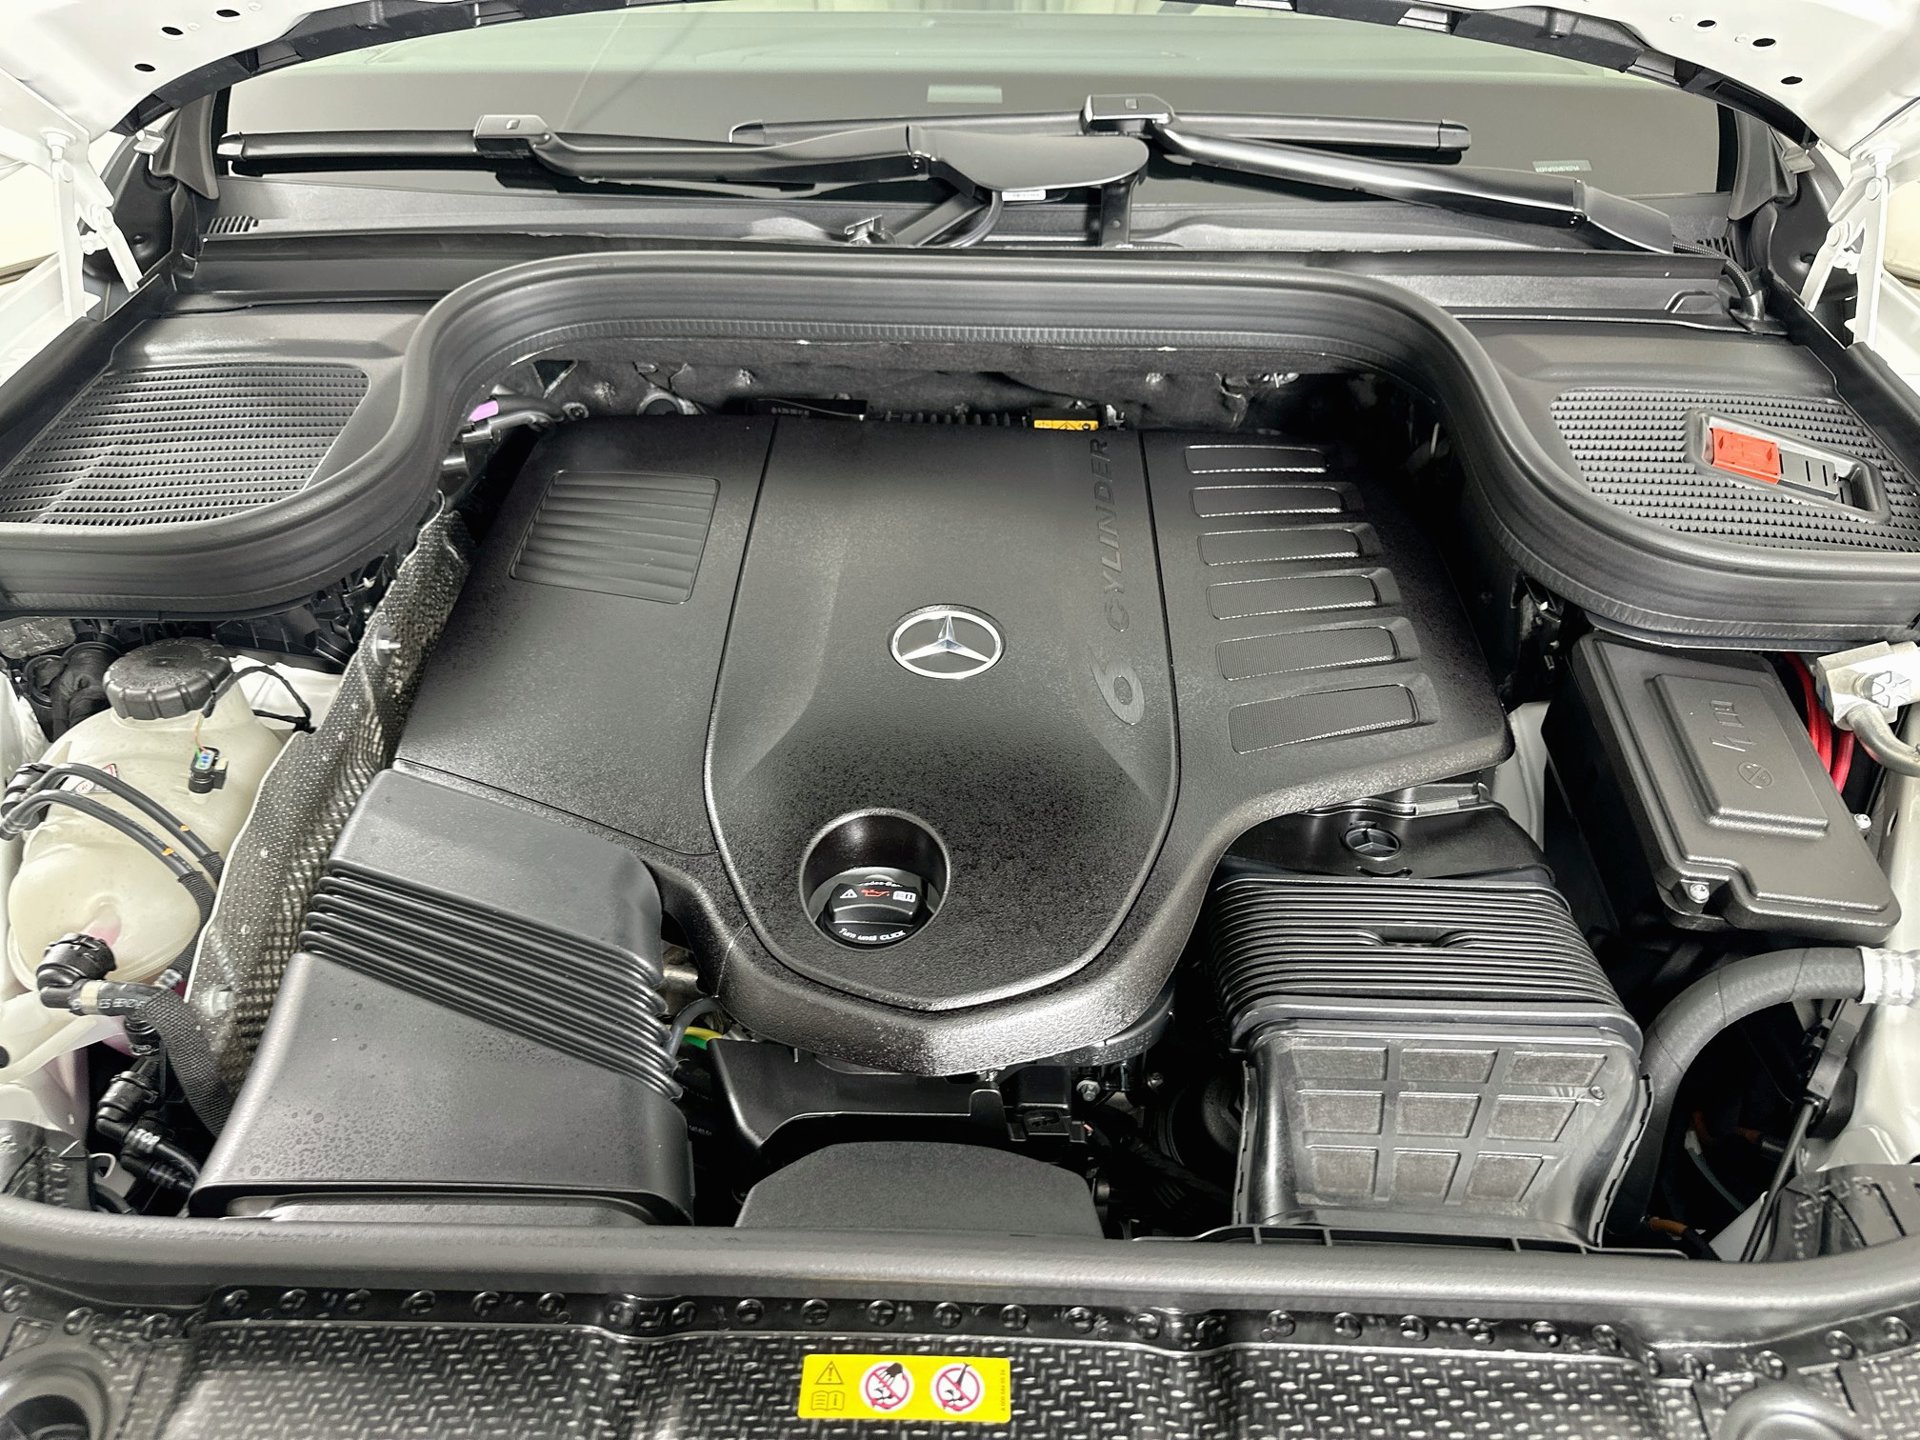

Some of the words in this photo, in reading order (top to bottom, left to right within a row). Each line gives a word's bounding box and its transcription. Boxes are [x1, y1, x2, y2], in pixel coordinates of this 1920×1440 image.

[1089, 437, 1130, 632] CYLINDER
[1090, 650, 1145, 725] 6
[838, 927, 857, 939] Turn
[879, 929, 906, 941] CLICK
